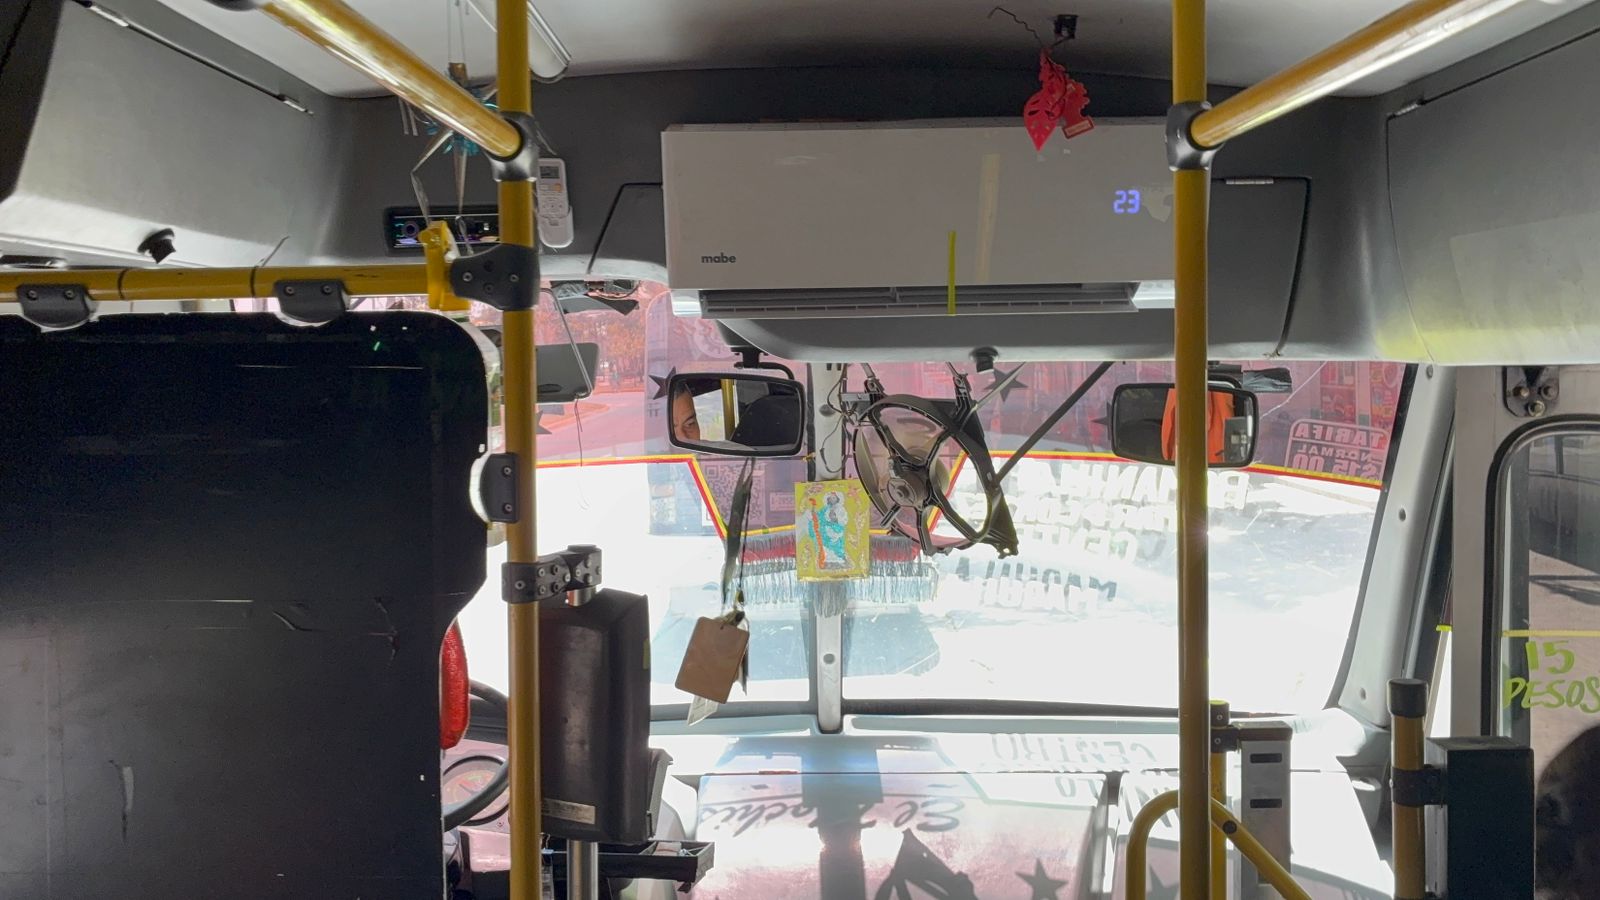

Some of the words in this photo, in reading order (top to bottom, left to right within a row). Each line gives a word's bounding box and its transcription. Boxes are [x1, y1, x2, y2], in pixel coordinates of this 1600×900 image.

[1113, 190, 1140, 213] 23
[701, 252, 737, 264] mabe
[1525, 641, 1574, 674] 15
[1503, 677, 1600, 713] PESOS
